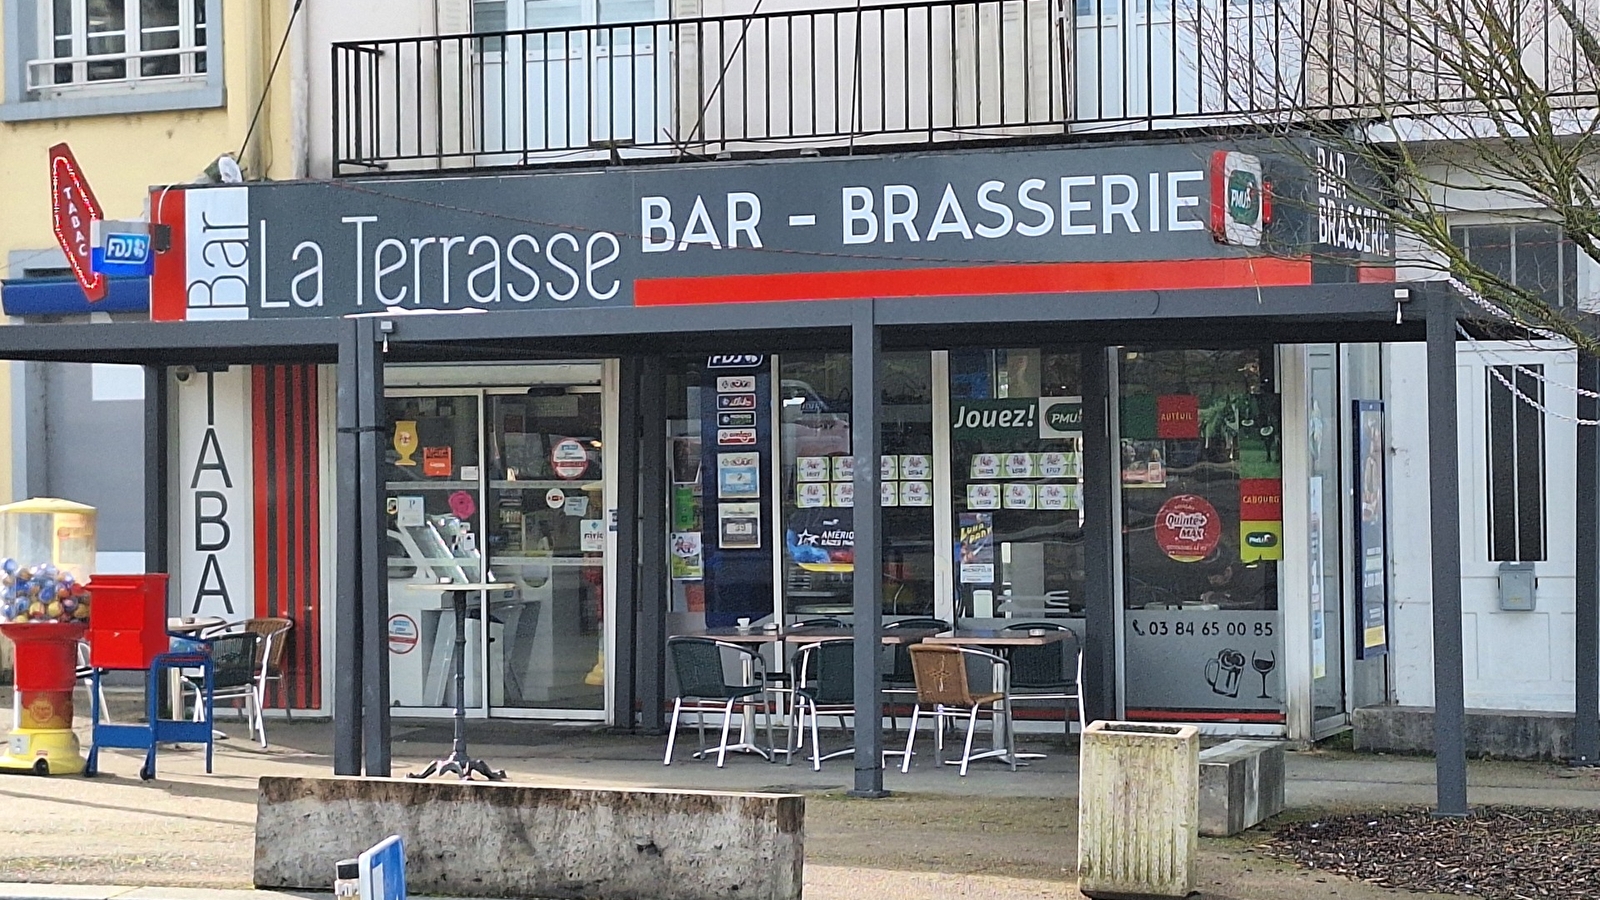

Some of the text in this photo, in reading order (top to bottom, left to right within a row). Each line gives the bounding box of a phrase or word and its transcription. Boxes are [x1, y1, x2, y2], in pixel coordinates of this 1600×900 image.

[1317, 147, 1347, 199] BAR
[63, 186, 88, 256] TABAC
[641, 170, 1204, 253] BAR - BRASSERIE
[1318, 197, 1390, 257] BRASSERIE
[107, 238, 133, 257] FDJ
[187, 211, 249, 309] Bar
[260, 216, 621, 308] La Terrasse
[954, 404, 1035, 429] Jouez!
[1051, 412, 1077, 425] PMU
[1161, 412, 1193, 421] AUTEUIL
[190, 365, 234, 632] TABA
[1242, 495, 1280, 504] CABOURG
[1180, 527, 1204, 541] MAX
[1149, 621, 1273, 636] 03 84 65 00 85
